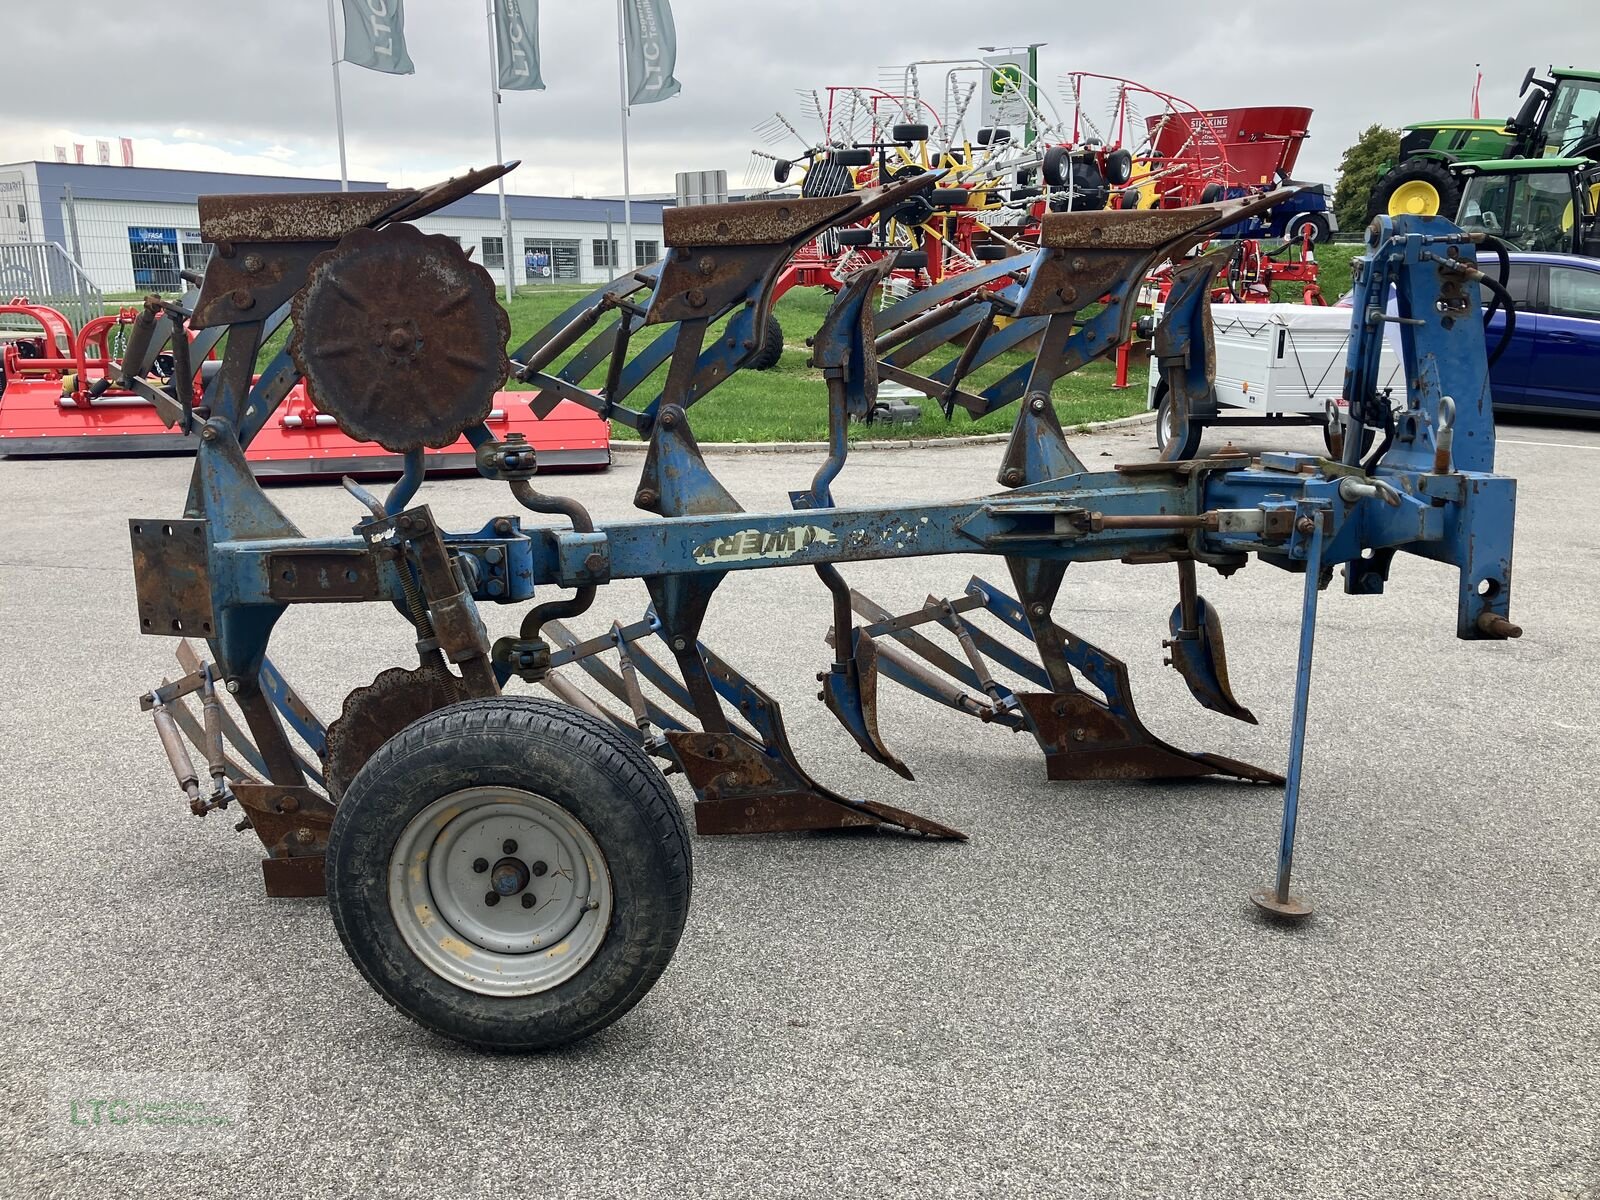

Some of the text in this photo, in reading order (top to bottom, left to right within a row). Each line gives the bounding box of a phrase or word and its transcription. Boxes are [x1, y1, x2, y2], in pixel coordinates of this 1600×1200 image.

[367, 0, 393, 56] LTC
[510, 22, 530, 77] LTC
[643, 42, 663, 91] LTC
